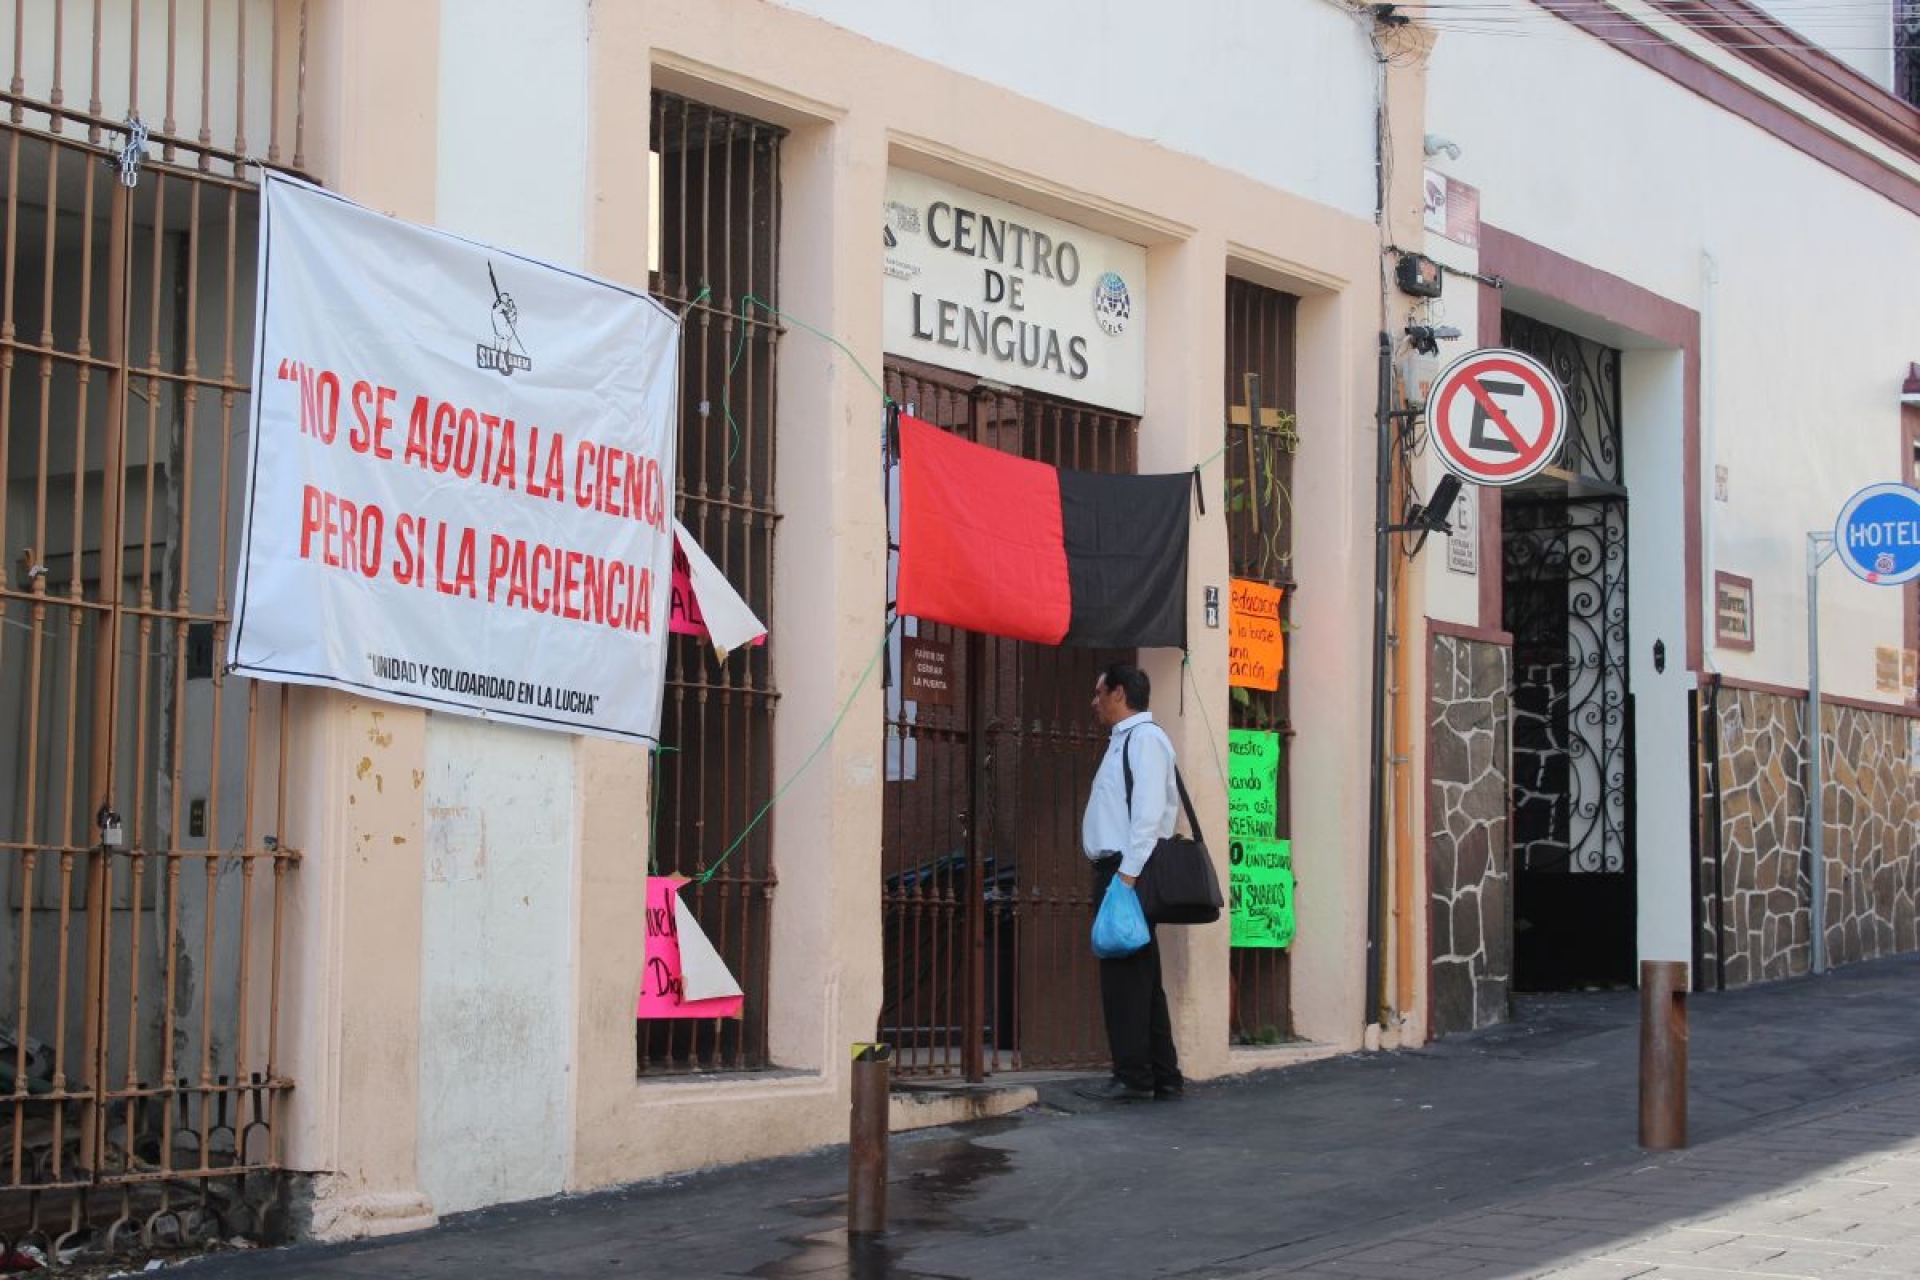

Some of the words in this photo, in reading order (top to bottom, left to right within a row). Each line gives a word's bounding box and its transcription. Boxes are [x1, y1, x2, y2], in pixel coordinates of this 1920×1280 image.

[927, 201, 1081, 287] CENTRO
[984, 268, 1025, 311] DE
[911, 292, 1089, 380] LENGUAS
[349, 380, 397, 460] SE
[404, 394, 517, 490] AGOTA
[526, 426, 565, 503] LA
[300, 484, 384, 579] PERO
[393, 513, 427, 588] SI
[436, 522, 477, 598] LA
[1850, 521, 1920, 548] HOTEL
[419, 664, 430, 686] Y
[431, 667, 516, 702] SOLIDARIDAD
[517, 682, 535, 706] EN
[537, 685, 552, 709] LA
[913, 676, 922, 687] LA
